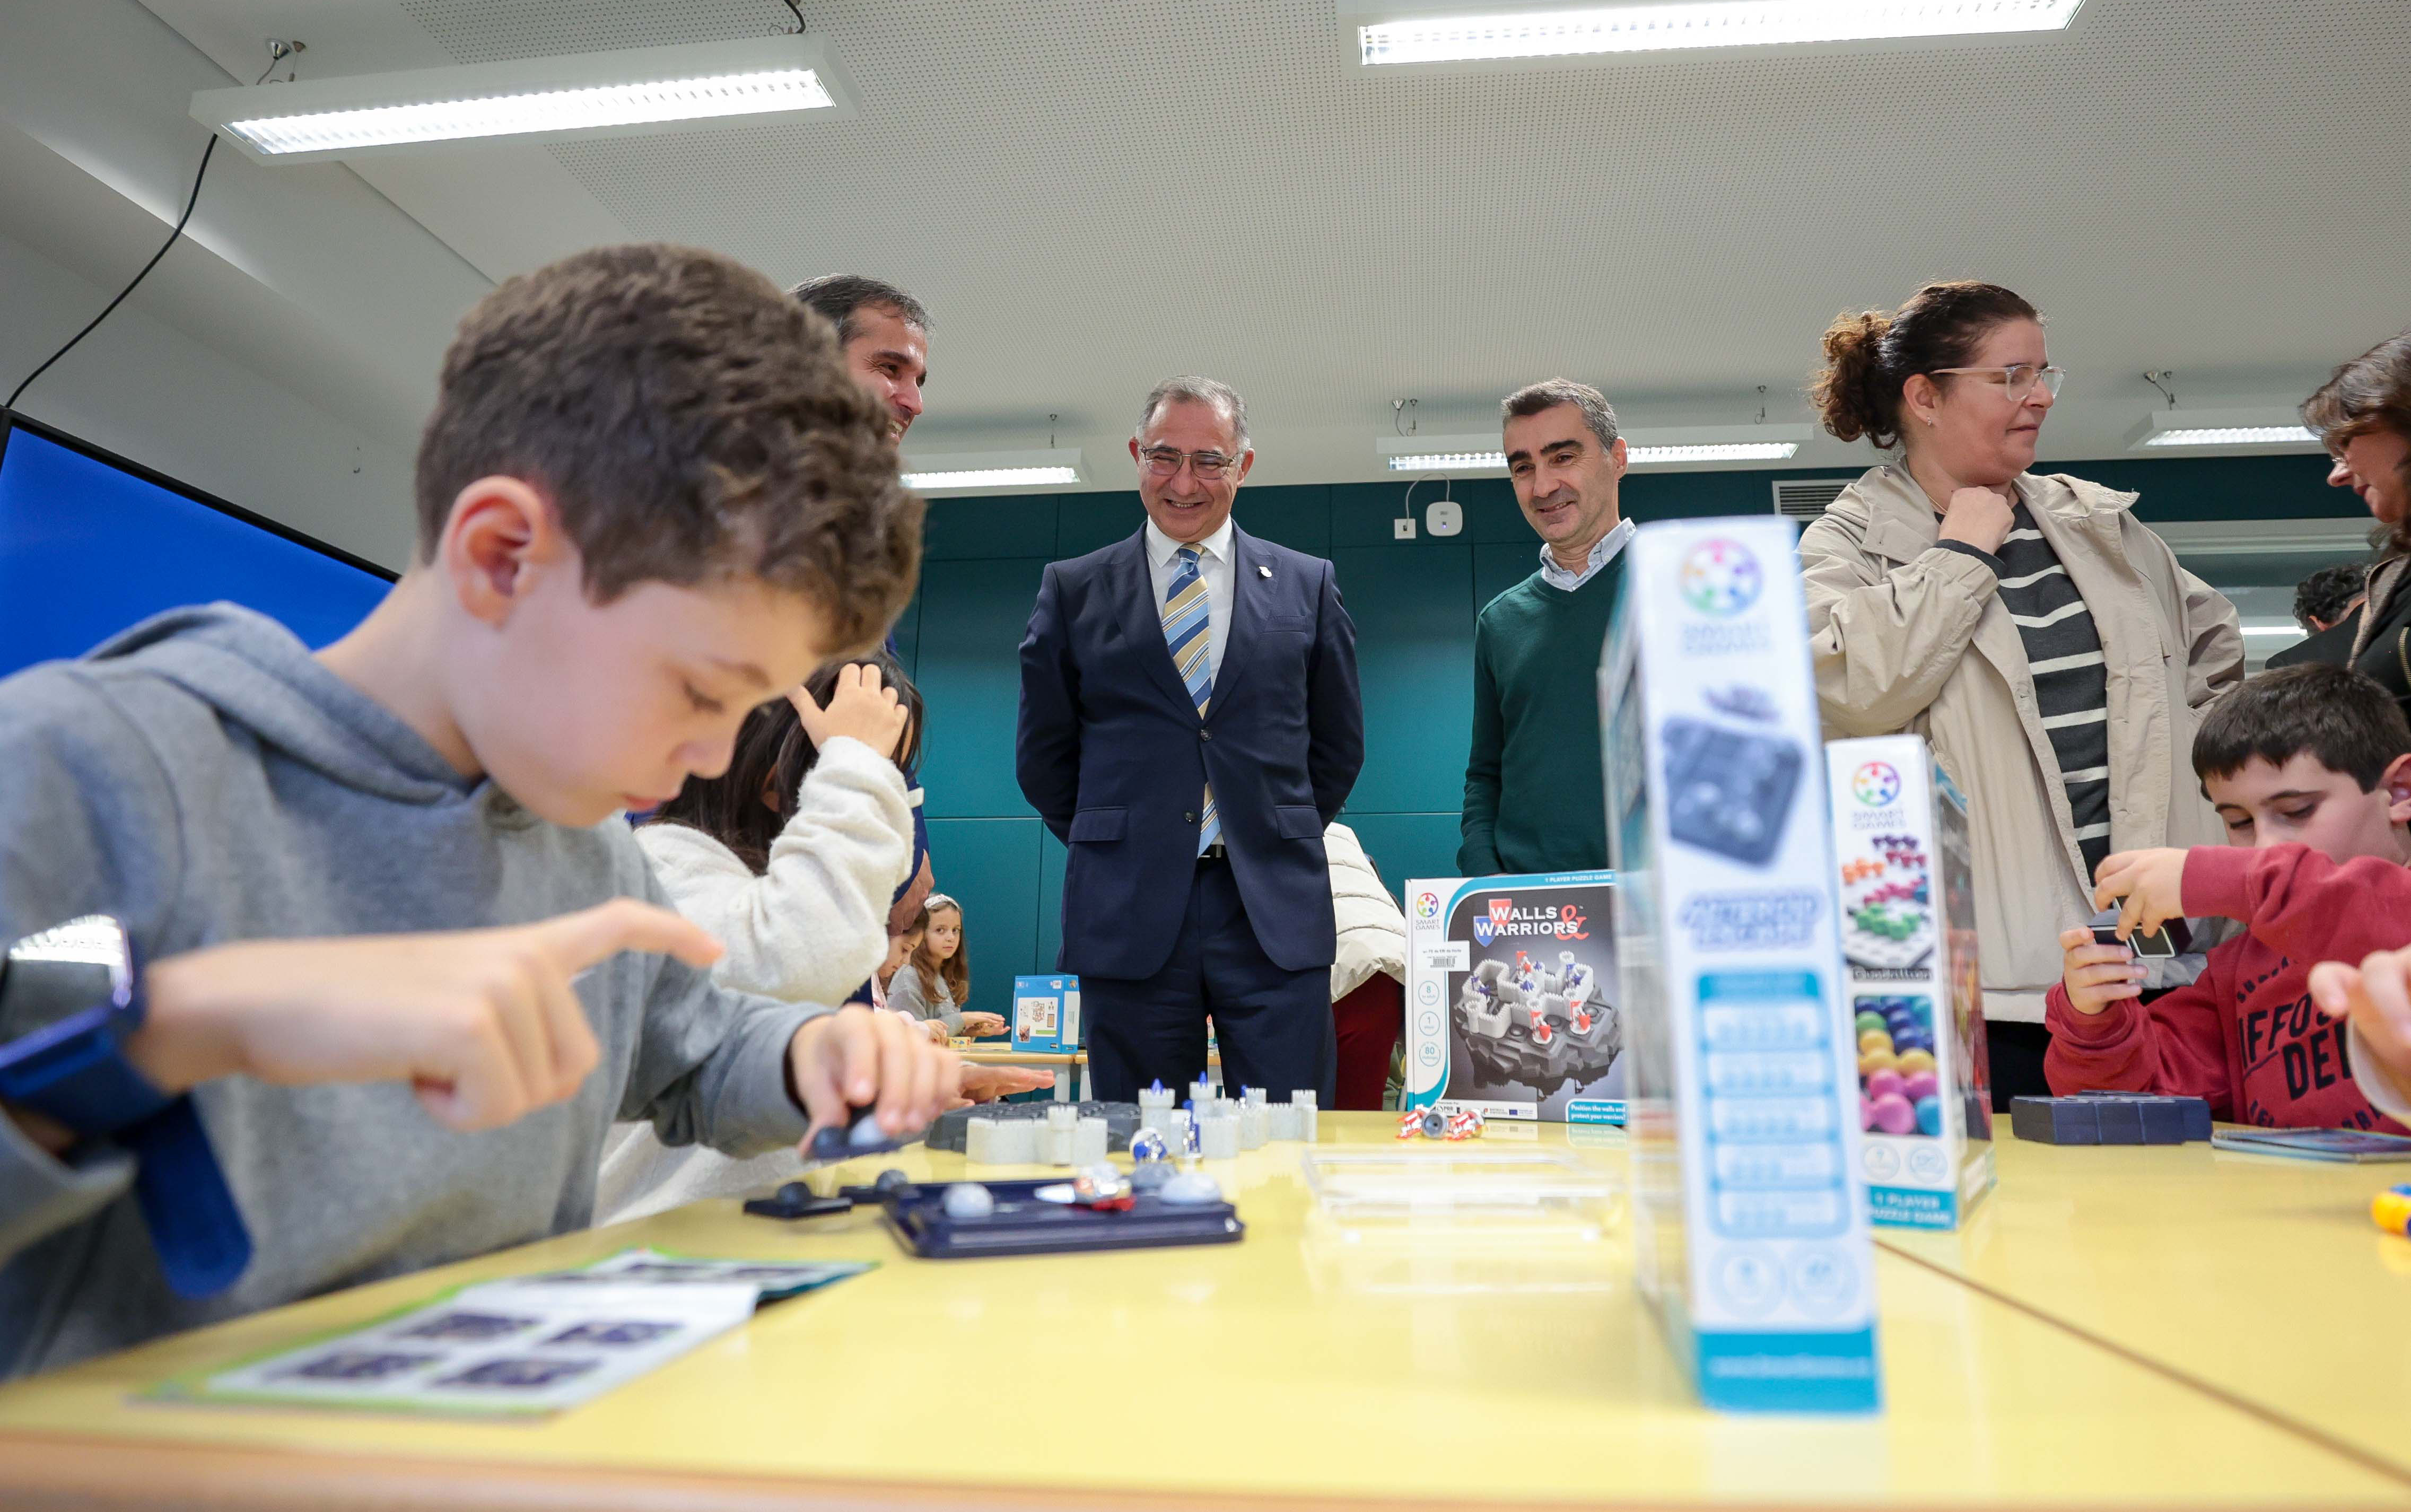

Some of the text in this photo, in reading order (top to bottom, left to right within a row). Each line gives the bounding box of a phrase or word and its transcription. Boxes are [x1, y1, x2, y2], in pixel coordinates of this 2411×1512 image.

[1490, 906, 1558, 921] WALLS
[1476, 921, 1578, 937] WARRIORS
[1427, 1016, 1431, 1025] 1
[1425, 1046, 1435, 1055] 80
